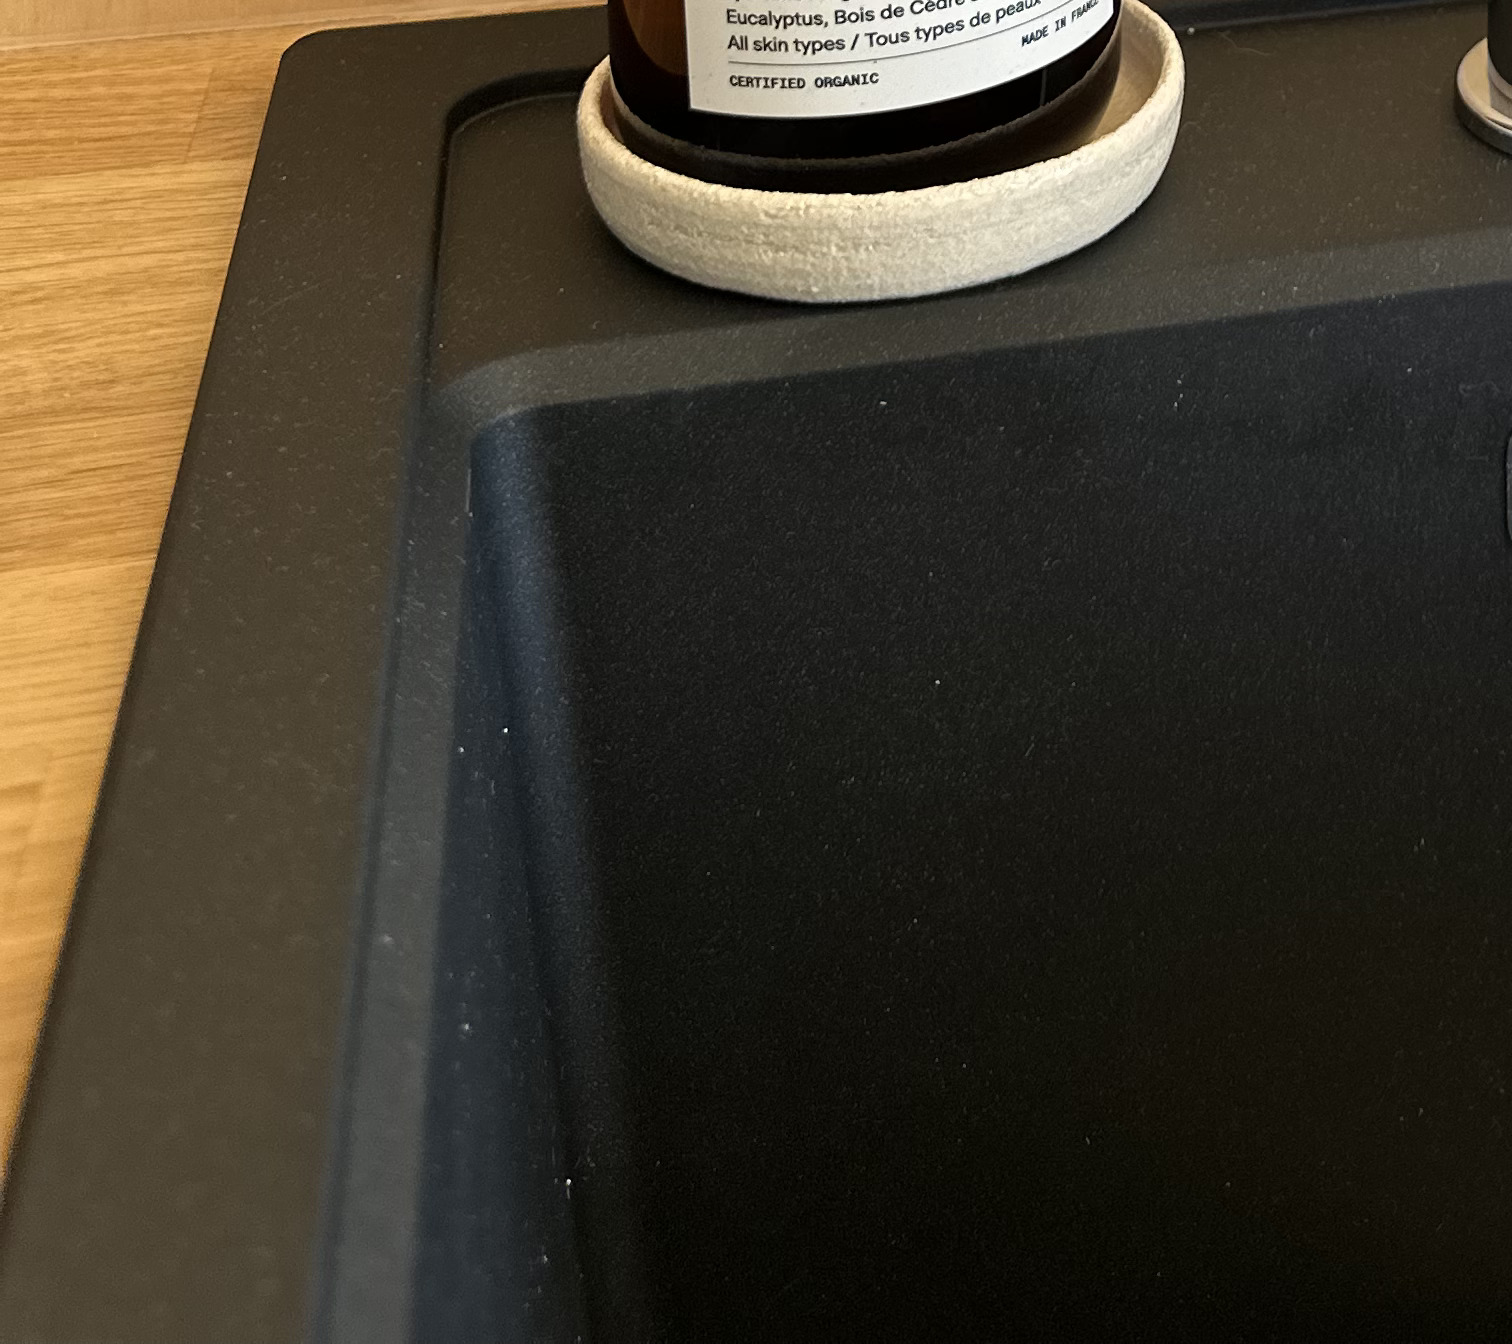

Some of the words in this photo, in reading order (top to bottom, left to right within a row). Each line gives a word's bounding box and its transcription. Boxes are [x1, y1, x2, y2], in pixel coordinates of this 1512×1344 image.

[726, 7, 829, 30] Eucalyptus,
[834, 7, 875, 25] Bois
[879, 2, 905, 21] de
[727, 35, 749, 51] All
[753, 34, 789, 52] skin
[793, 35, 846, 55] types
[850, 34, 859, 51] /
[864, 28, 911, 49] Tous
[915, 19, 965, 44] types
[969, 12, 991, 28] de
[1021, 24, 1049, 48] MADE
[1055, 17, 1067, 33] IN
[729, 74, 806, 89] CERTIFIED
[814, 72, 879, 89] ORGANIC
